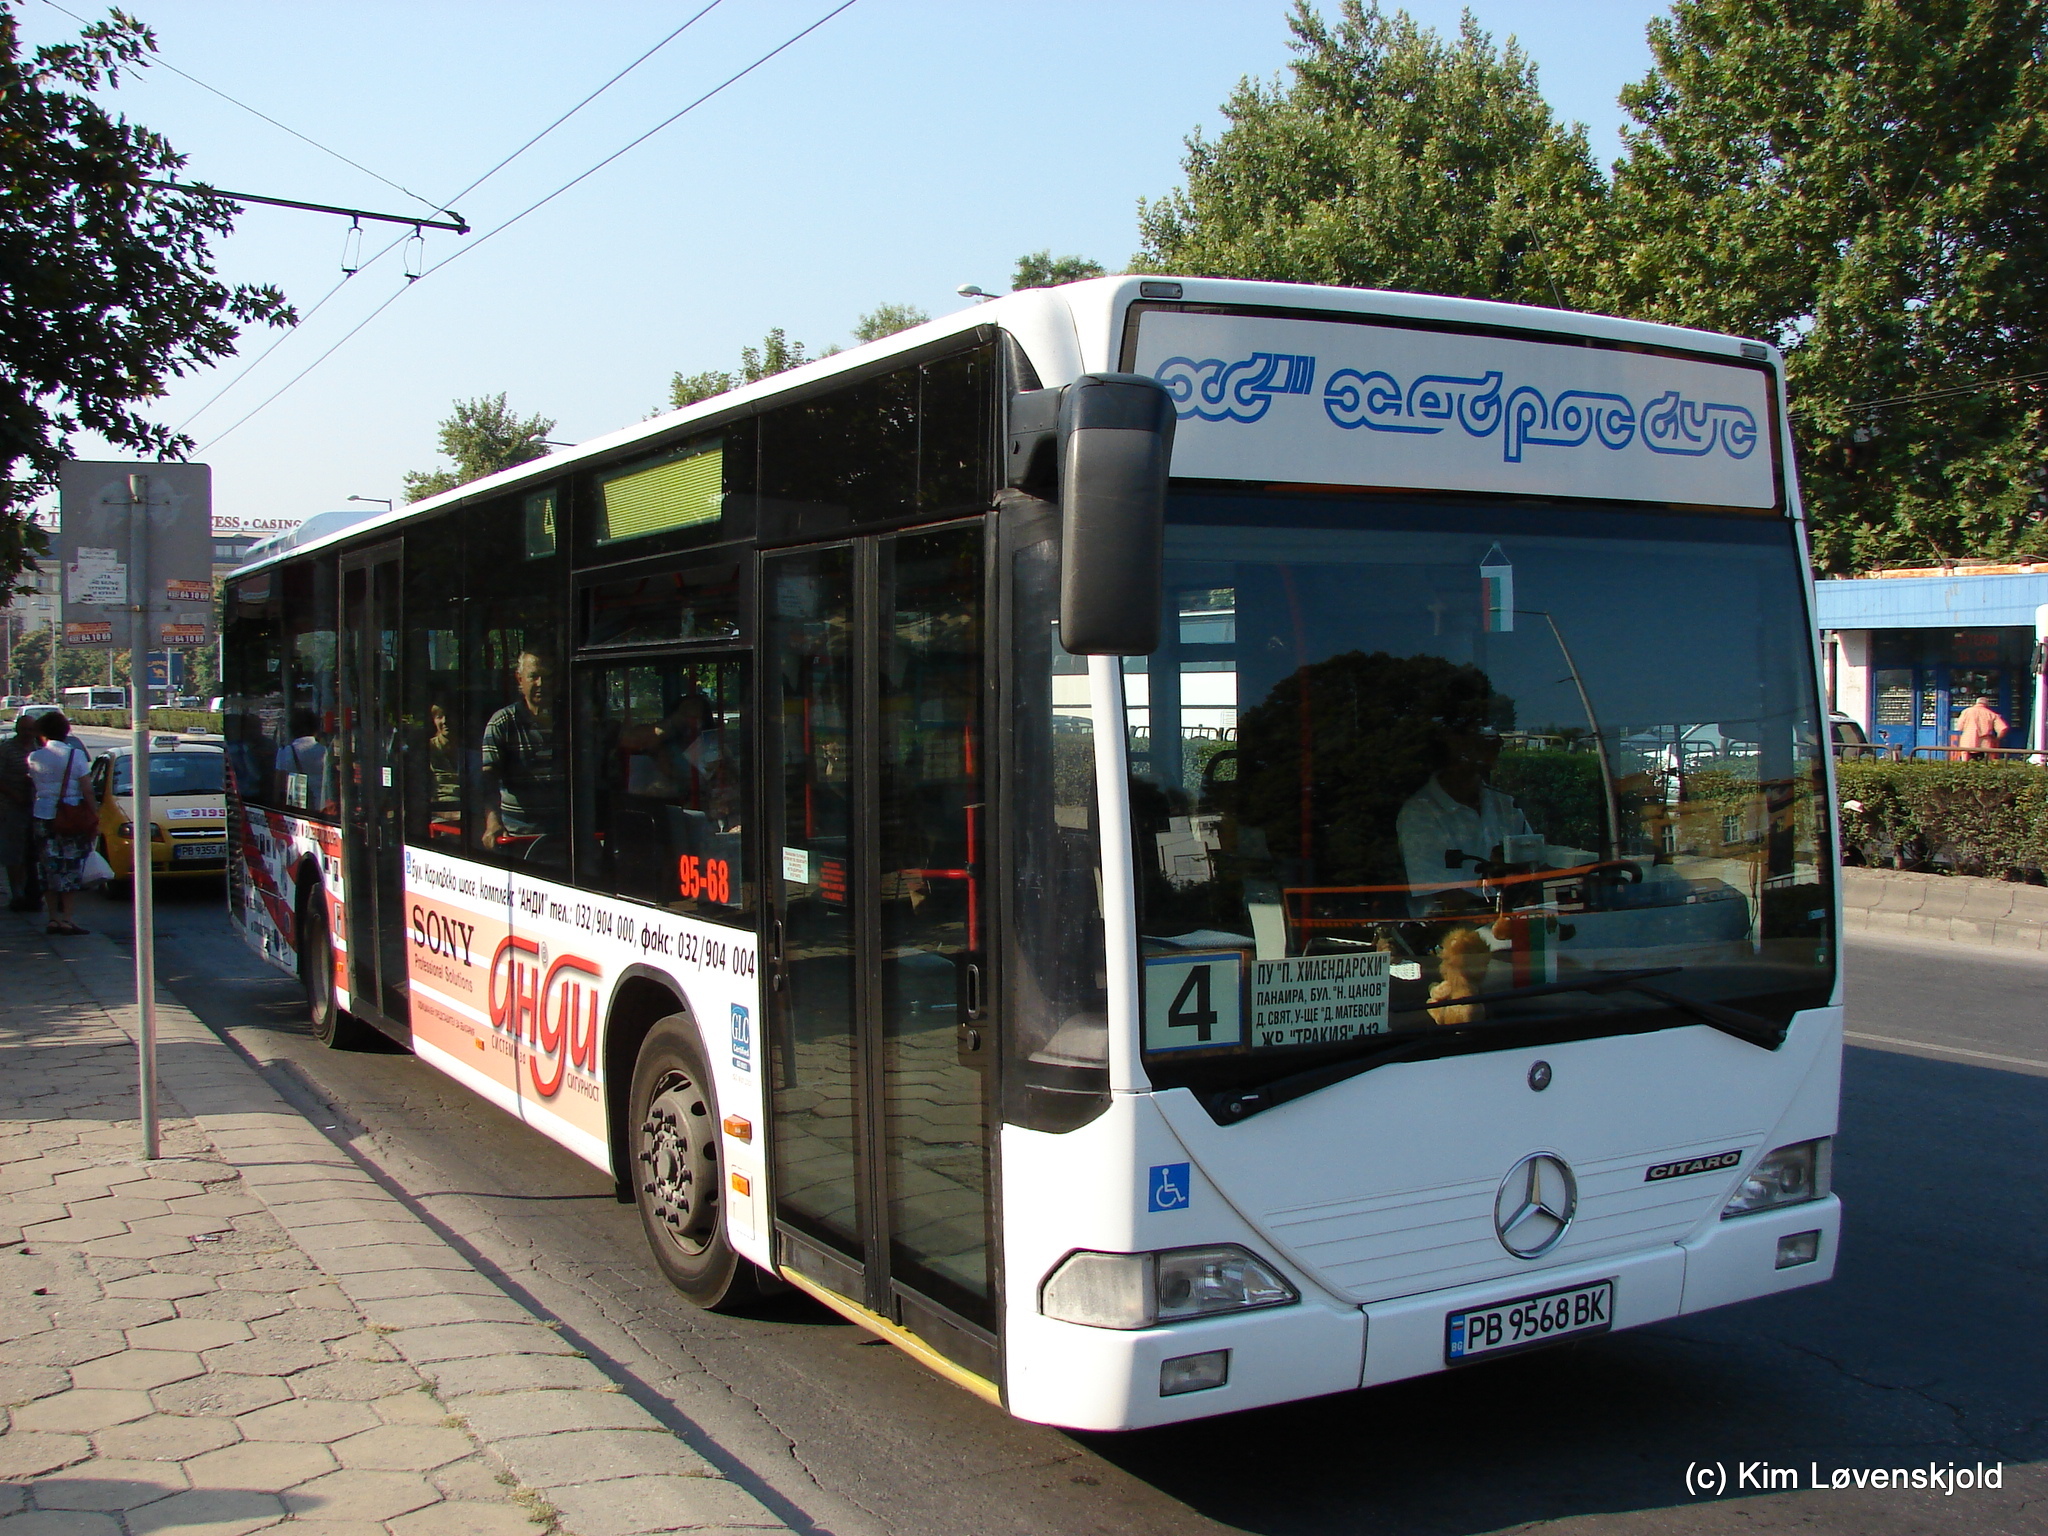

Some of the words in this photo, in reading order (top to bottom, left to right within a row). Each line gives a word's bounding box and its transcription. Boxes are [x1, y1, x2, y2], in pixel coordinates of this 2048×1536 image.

[544, 498, 556, 550] 4
[680, 854, 730, 904] 95-68
[413, 904, 474, 968] SONY
[575, 903, 613, 937] 032/904
[617, 914, 637, 948] 000,
[641, 922, 674, 956] факс:
[678, 932, 726, 972] 032/904
[733, 946, 755, 979] 004
[414, 953, 444, 979] Professional
[445, 966, 474, 993] Solutions
[1257, 963, 1274, 985] ПУ
[1277, 961, 1293, 983] "П.
[1296, 955, 1387, 983] ХИЛЕНДАРСКИ"
[1168, 964, 1218, 1041] 4
[1310, 986, 1331, 1002] БУЛ.
[1348, 982, 1386, 1001] ЦАНОВ"
[732, 1012, 750, 1044] GLC
[1294, 1007, 1319, 1024] У-ЩЕ
[1335, 1002, 1385, 1020] МАТЕВСКИ"
[1290, 1024, 1354, 1044] "ТРАКИЯ"
[567, 1073, 600, 1102] СИГУРНОСТ
[1649, 1153, 1739, 1178] CITARO
[1451, 1341, 1463, 1353] BG
[1468, 1312, 1503, 1349] PB
[1509, 1298, 1569, 1341] 9568
[1574, 1289, 1605, 1326] BK
